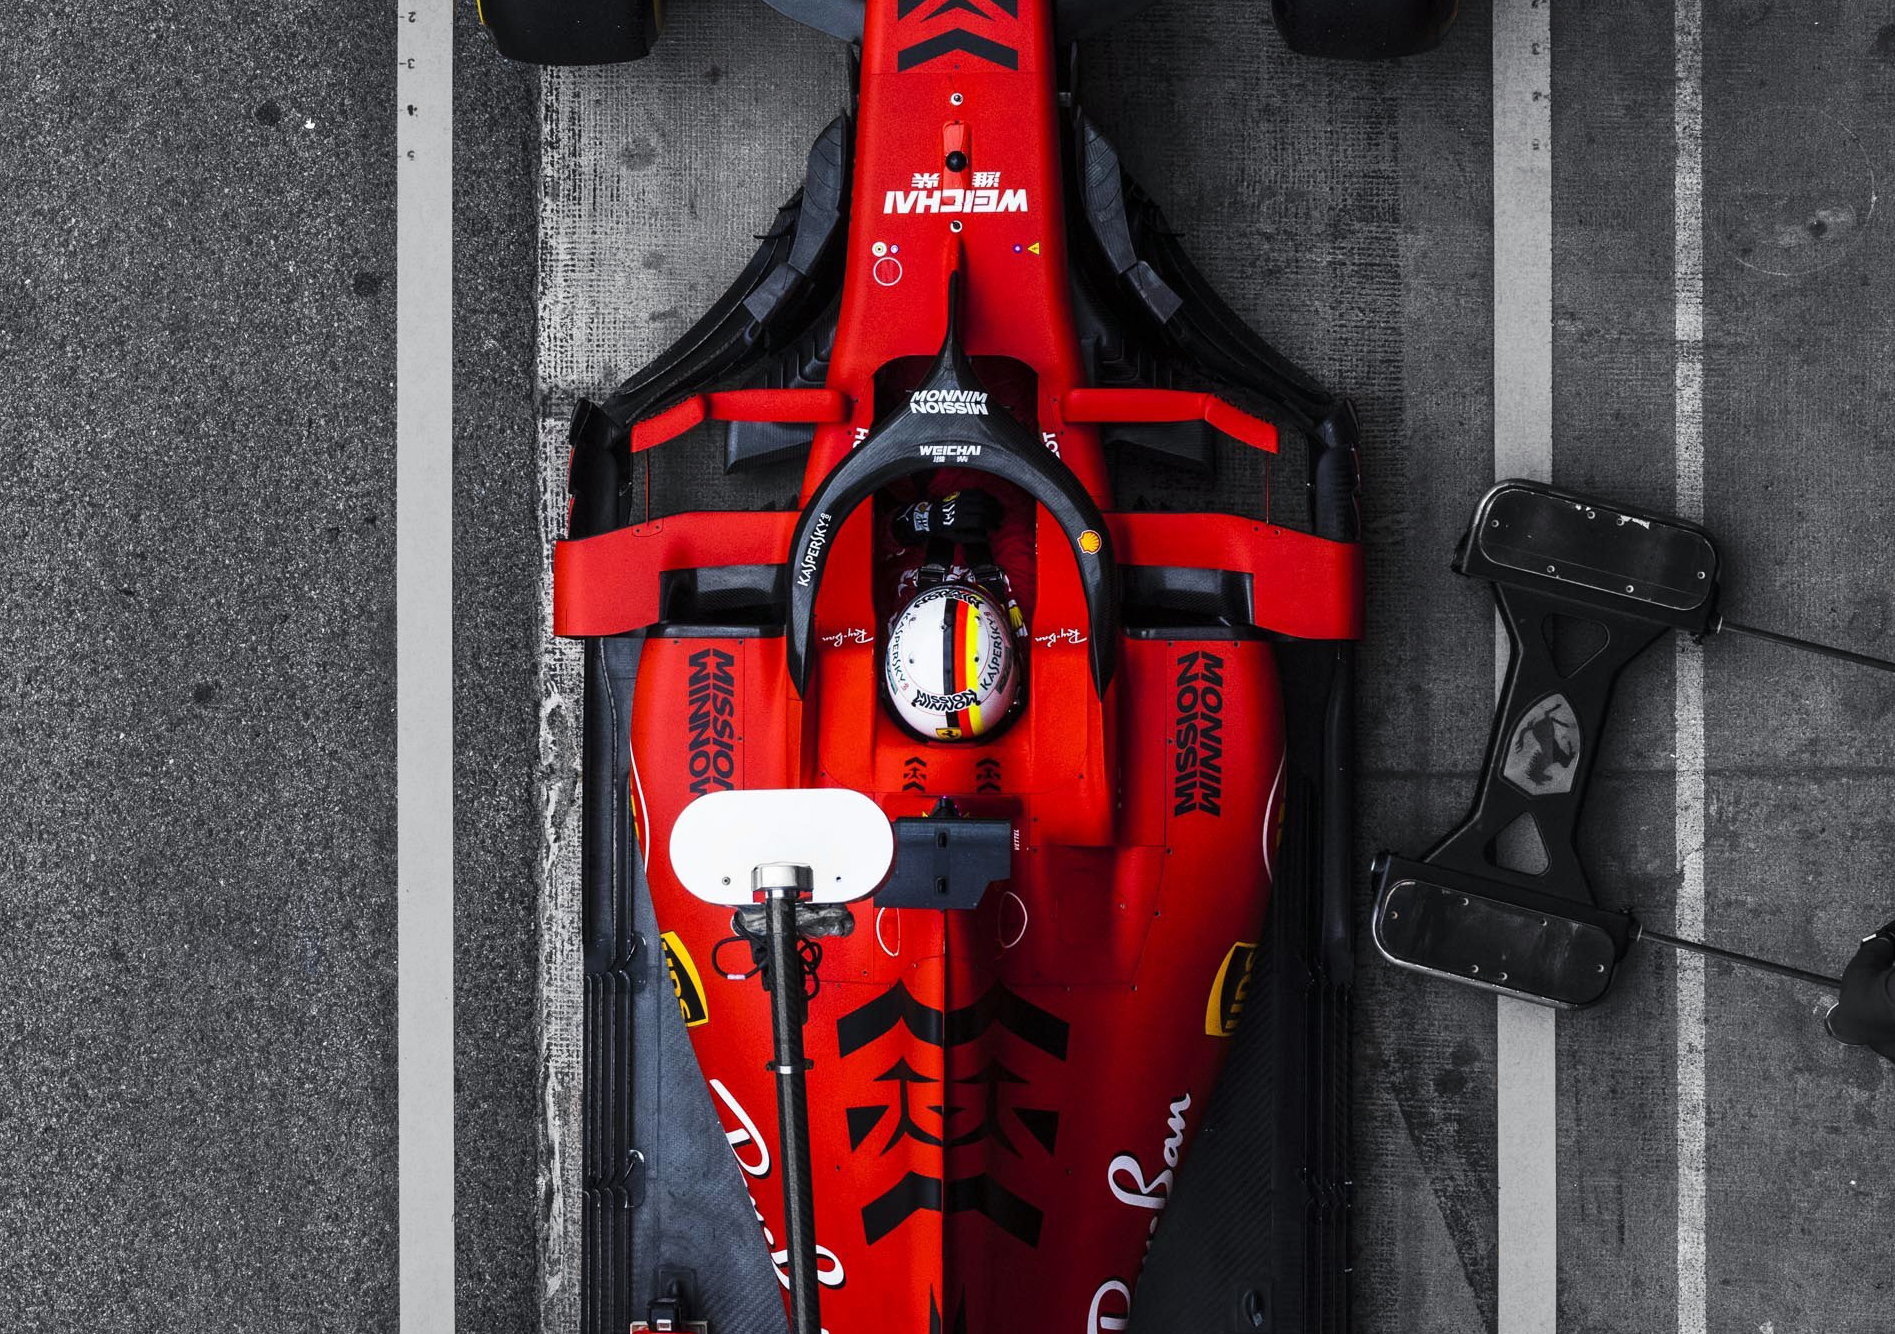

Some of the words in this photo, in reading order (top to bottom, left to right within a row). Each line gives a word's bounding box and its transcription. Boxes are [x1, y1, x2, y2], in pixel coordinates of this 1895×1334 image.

[407, 11, 416, 23] 2
[407, 58, 416, 69] 3
[883, 188, 1029, 214] WEICHAI
[910, 390, 989, 404] WINNOW
[909, 402, 989, 415] MISSION
[919, 445, 981, 456] WEICHAI
[797, 518, 829, 587] KASPERSKY
[822, 627, 874, 648] Ray-Ban
[892, 612, 908, 682] KASPERSKY
[1034, 627, 1088, 648] Ray-Ban
[980, 616, 1003, 691] KASPERSKY
[916, 689, 980, 705] MISSION
[1173, 650, 1201, 818] MISSION
[1199, 650, 1225, 818] WINNOW
